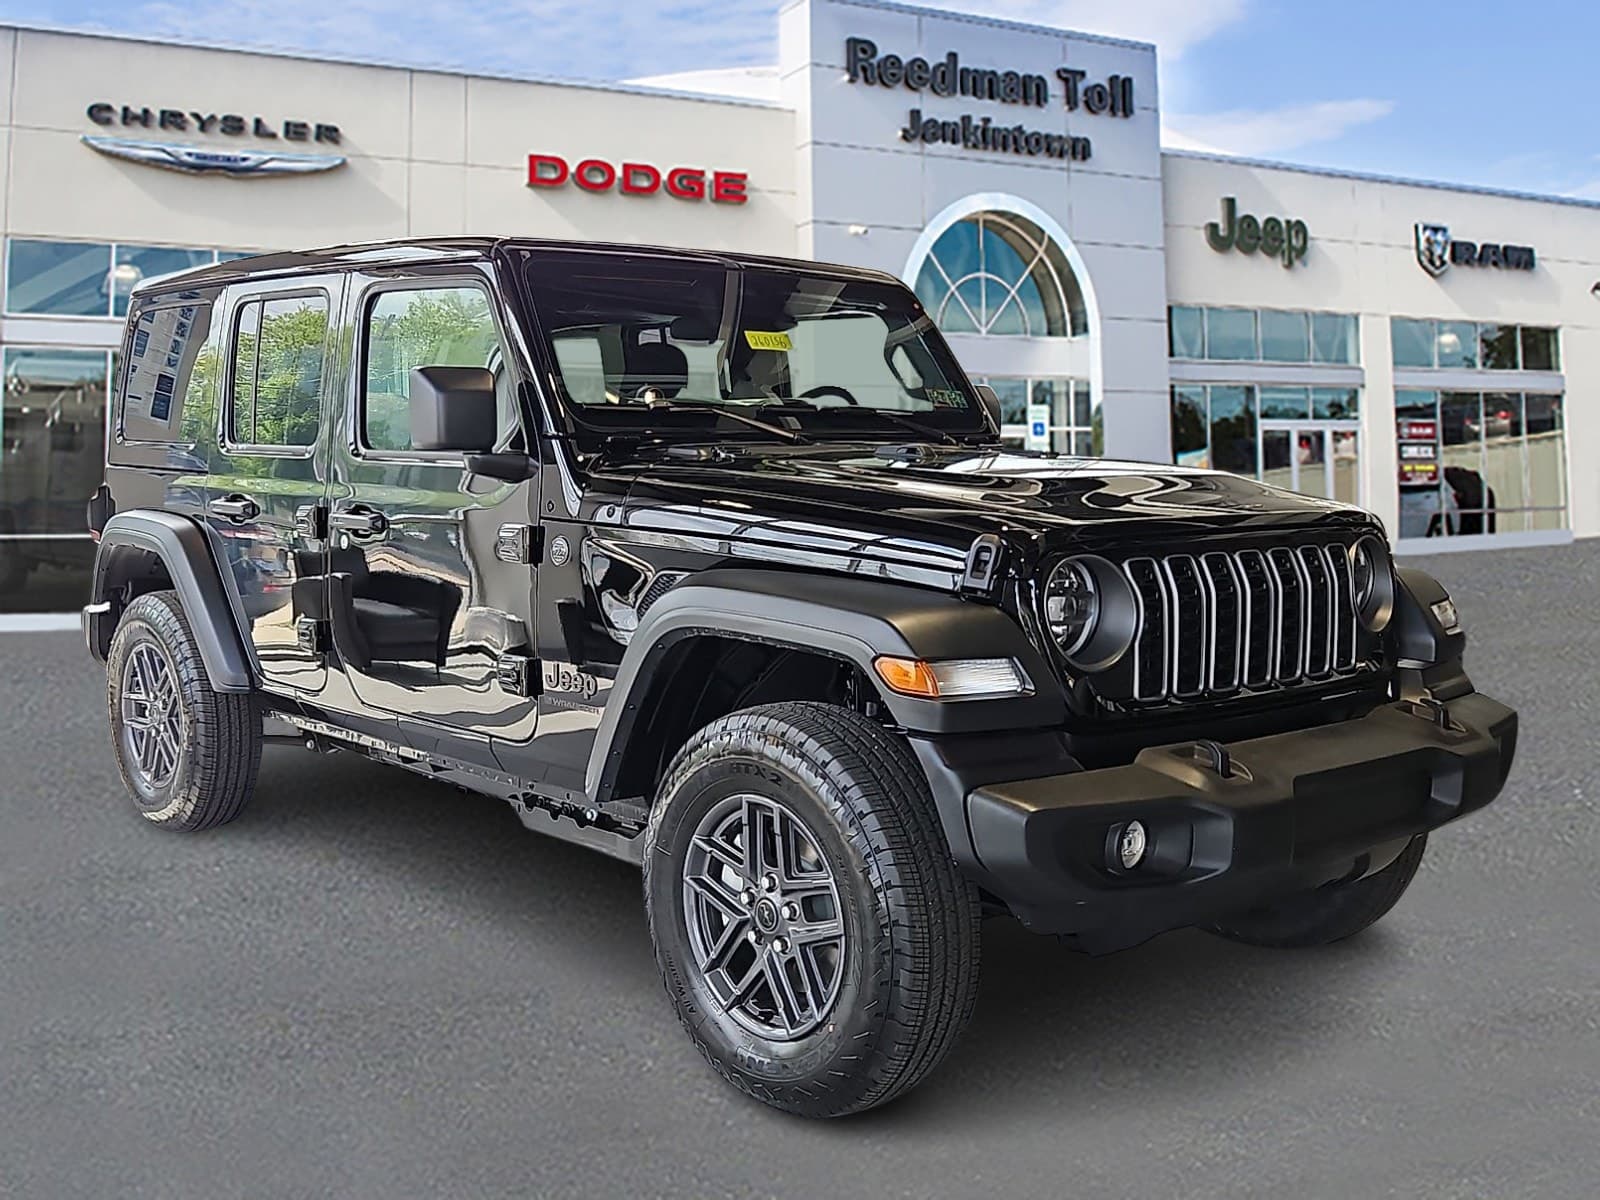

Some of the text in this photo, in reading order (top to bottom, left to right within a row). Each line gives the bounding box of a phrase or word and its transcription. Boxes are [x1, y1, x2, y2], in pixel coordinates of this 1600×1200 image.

[845, 36, 1135, 119] Reedman Toll
[86, 102, 342, 145] CHRYSLER
[900, 108, 1092, 161] Jenkintown
[527, 153, 749, 205] DODGE
[1205, 197, 1309, 270] Jeep
[1449, 241, 1536, 271] RAM
[544, 662, 598, 701] Jeep
